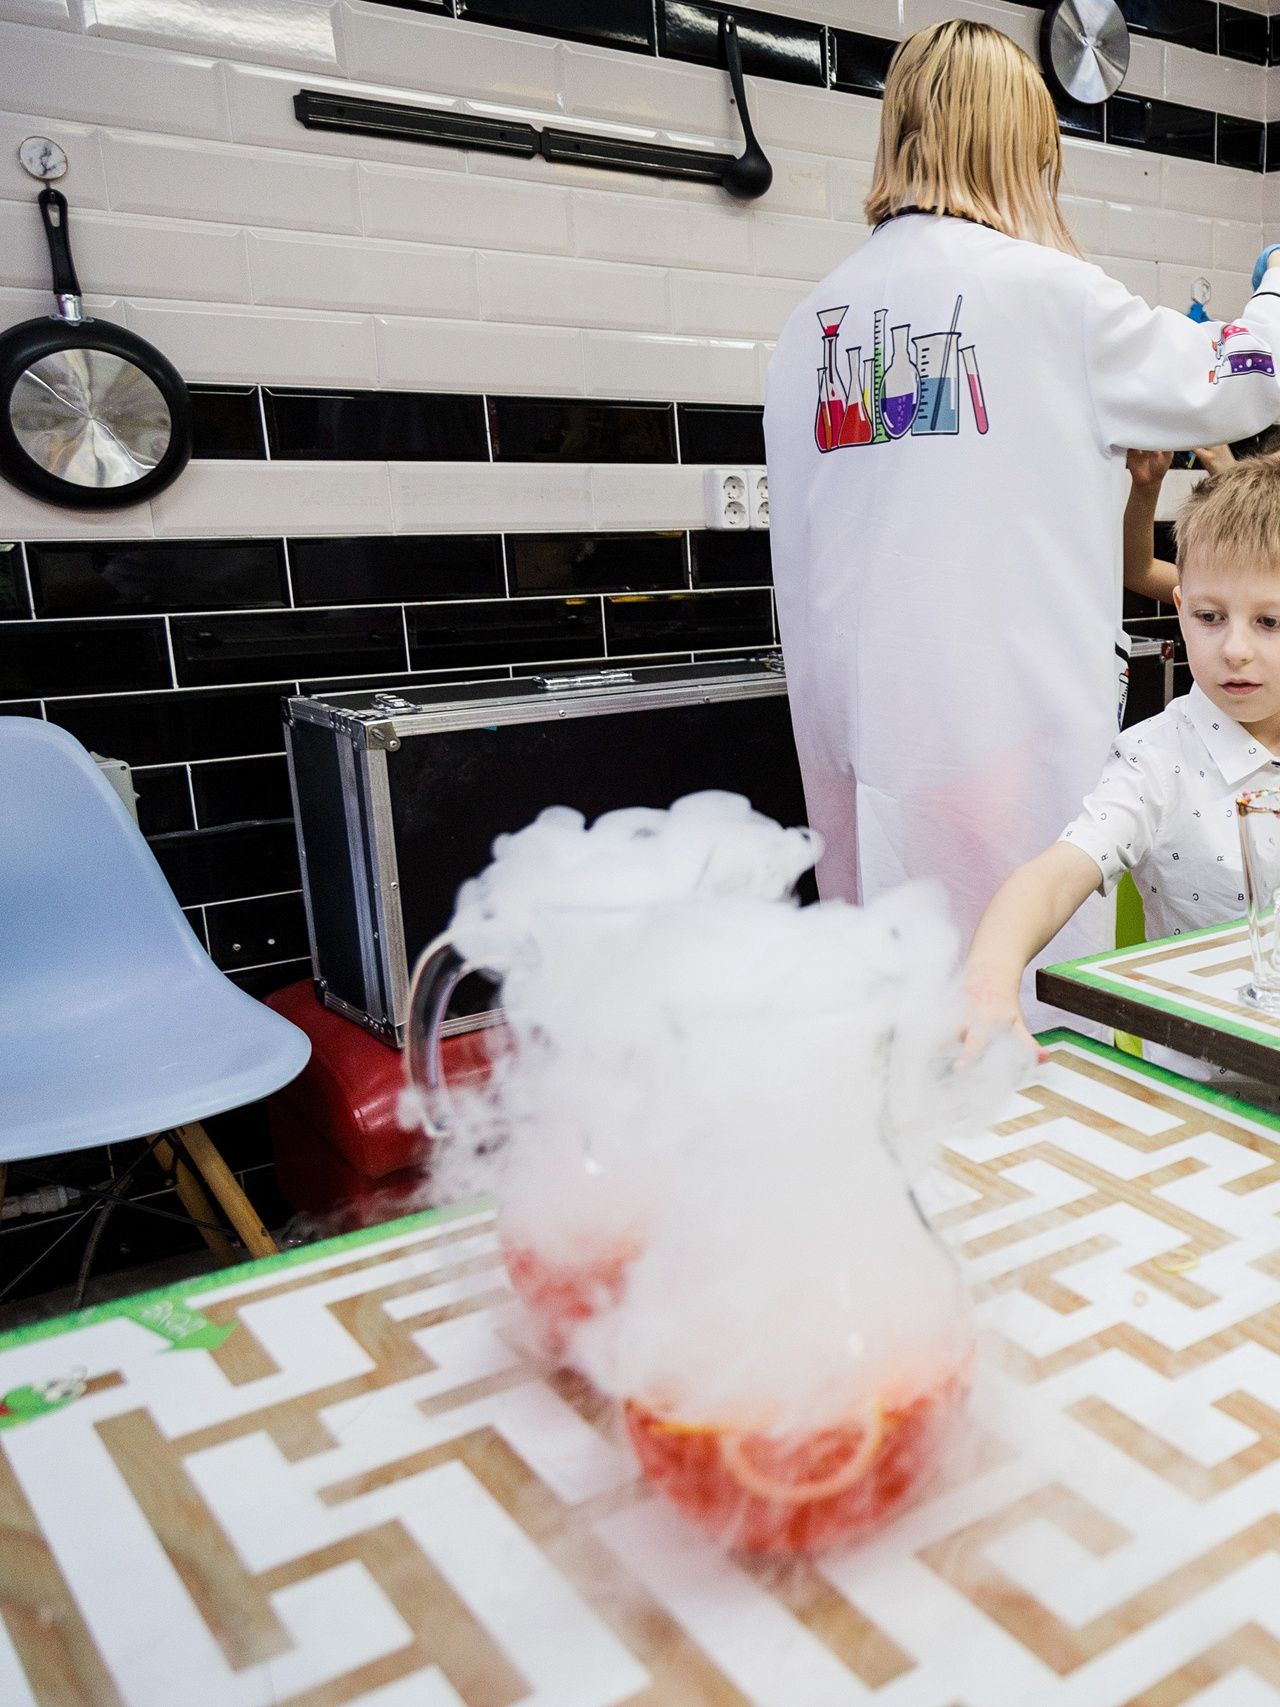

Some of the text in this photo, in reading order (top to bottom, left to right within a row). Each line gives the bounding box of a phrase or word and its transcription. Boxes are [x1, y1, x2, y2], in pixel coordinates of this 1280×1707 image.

[1212, 722, 1220, 730] B
[1115, 750, 1121, 758] B
[1248, 747, 1257, 755] C
[1174, 765, 1181, 774] C
[1101, 812, 1107, 820] C
[1226, 809, 1232, 818] C
[1172, 852, 1179, 861] B
[1192, 893, 1199, 901] C
[1238, 893, 1244, 901] B
